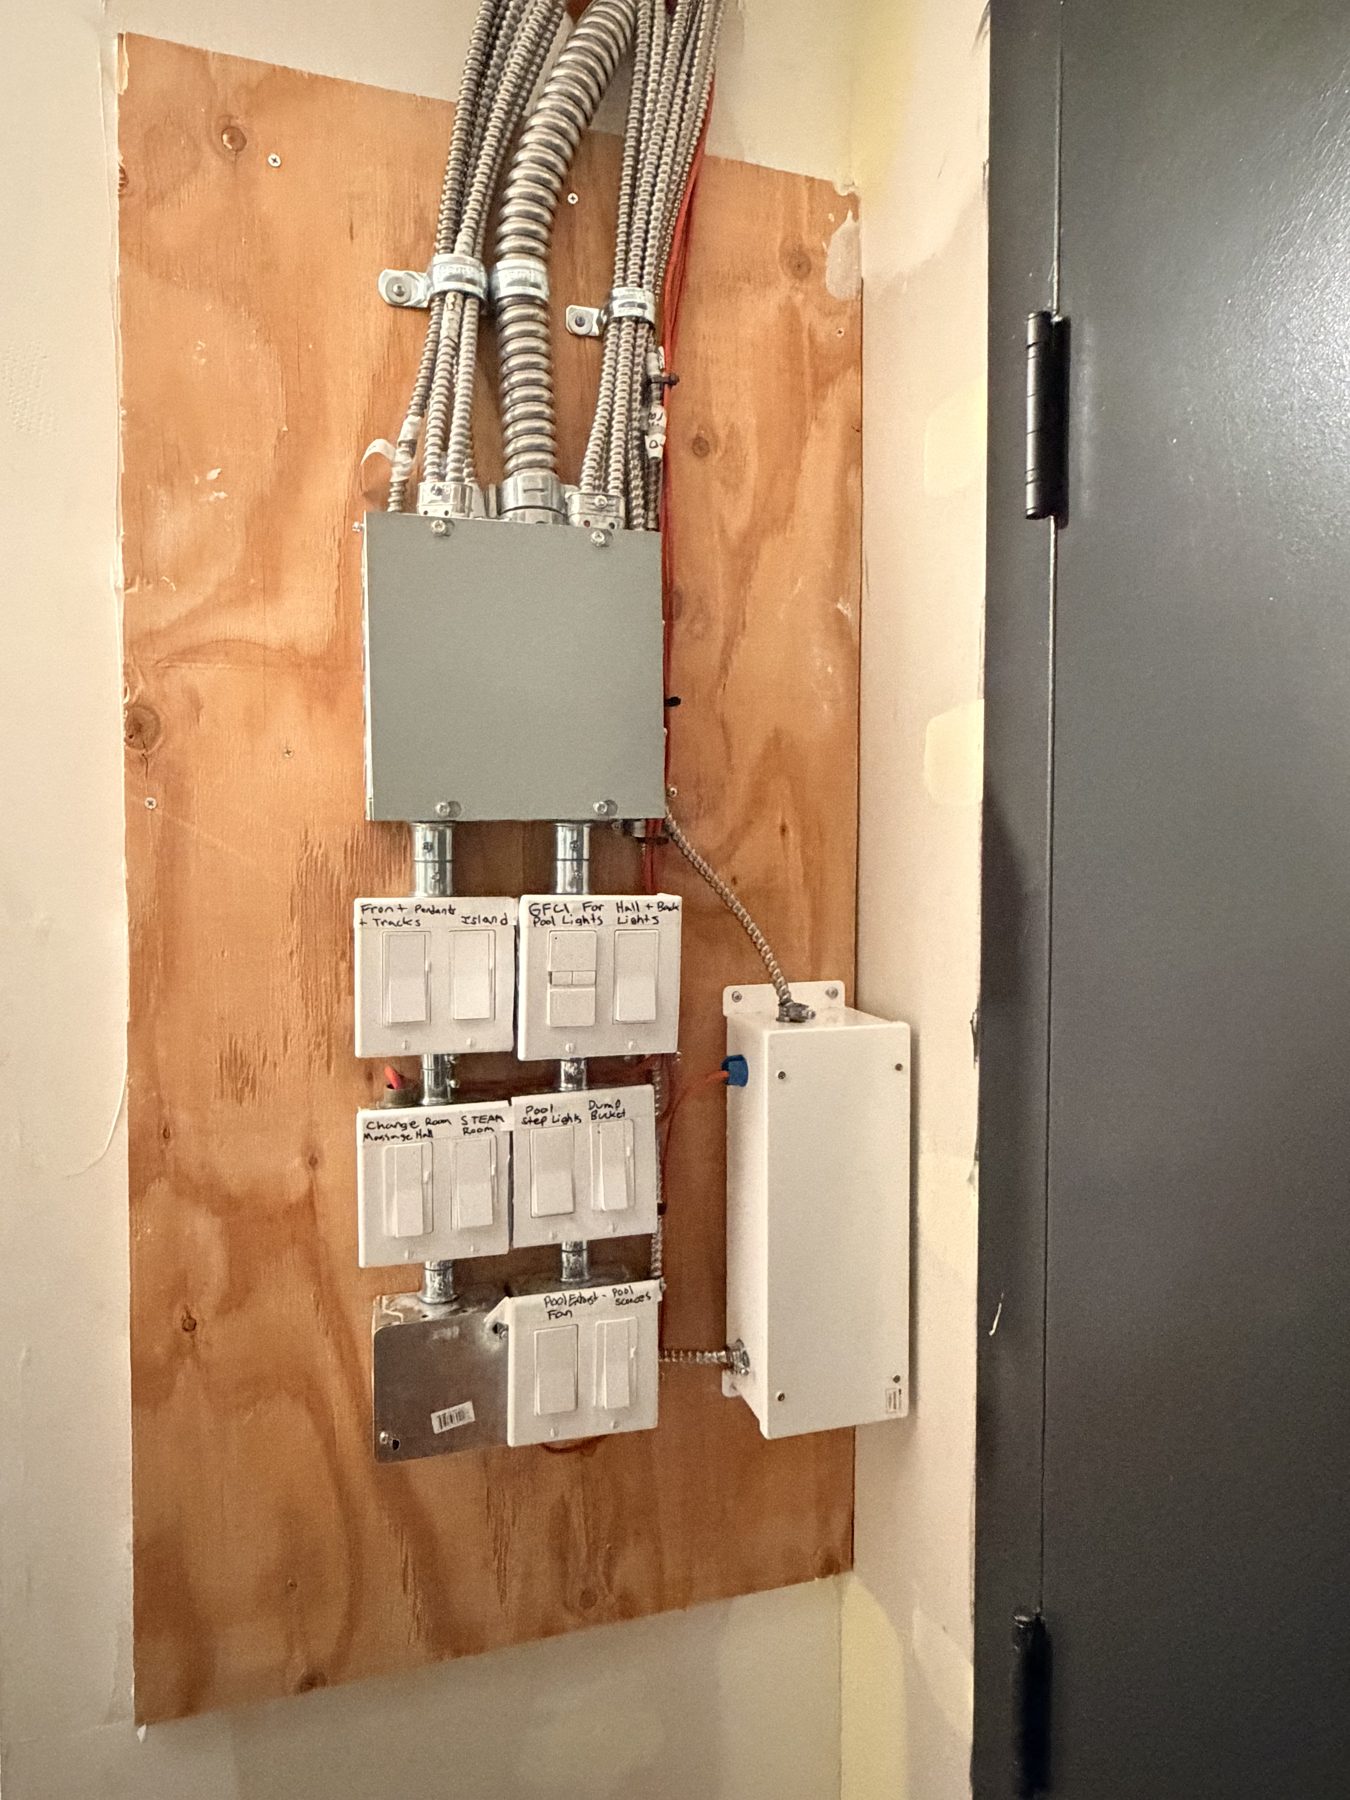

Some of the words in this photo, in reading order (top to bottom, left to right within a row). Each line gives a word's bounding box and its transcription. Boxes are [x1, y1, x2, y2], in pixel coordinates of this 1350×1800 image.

[360, 903, 408, 914] Front
[616, 901, 640, 913] Hall
[372, 917, 421, 927] Tracks
[461, 913, 509, 926] Island
[533, 916, 556, 927] Pool
[562, 913, 603, 926] Lights
[617, 915, 660, 925] Lights
[525, 1104, 554, 1115] Pool
[588, 1099, 621, 1111] Dump
[551, 1113, 582, 1125] Lights
[366, 1120, 419, 1131] Change
[462, 1125, 495, 1136] Room
[611, 1285, 634, 1297] Pool
[543, 1294, 567, 1308] Pool
[547, 1309, 573, 1320] Fan
